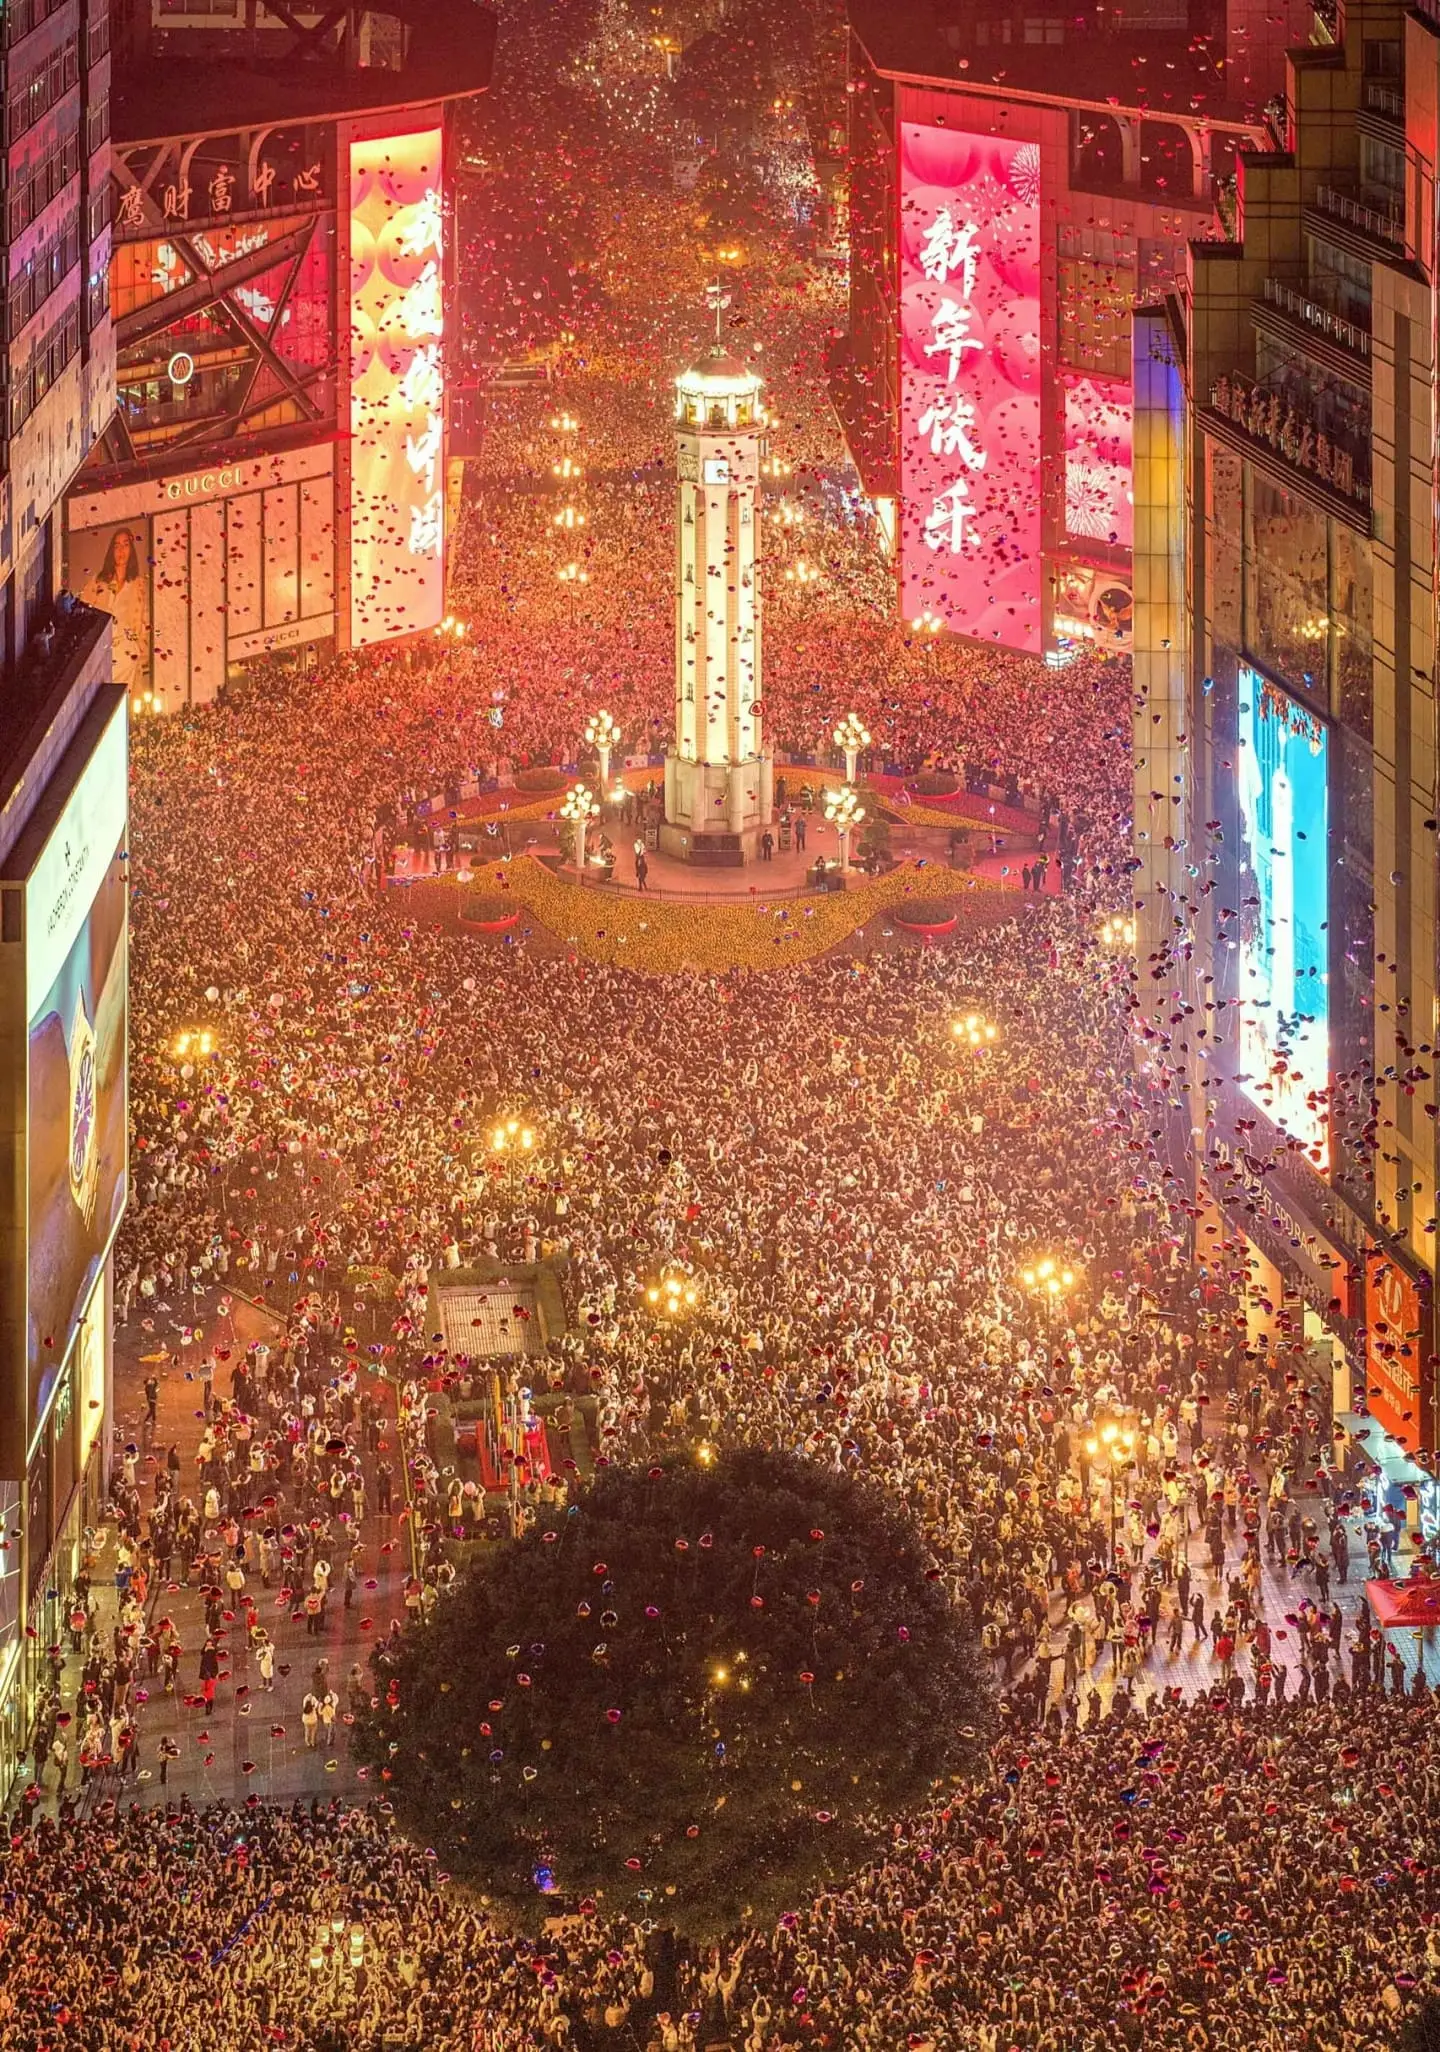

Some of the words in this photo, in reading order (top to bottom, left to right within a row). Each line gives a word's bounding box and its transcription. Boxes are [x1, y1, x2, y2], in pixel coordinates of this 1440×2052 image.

[115, 161, 321, 227] 鹰财富中心
[918, 207, 987, 553] 新年快乐
[167, 468, 242, 499] GUCCI
